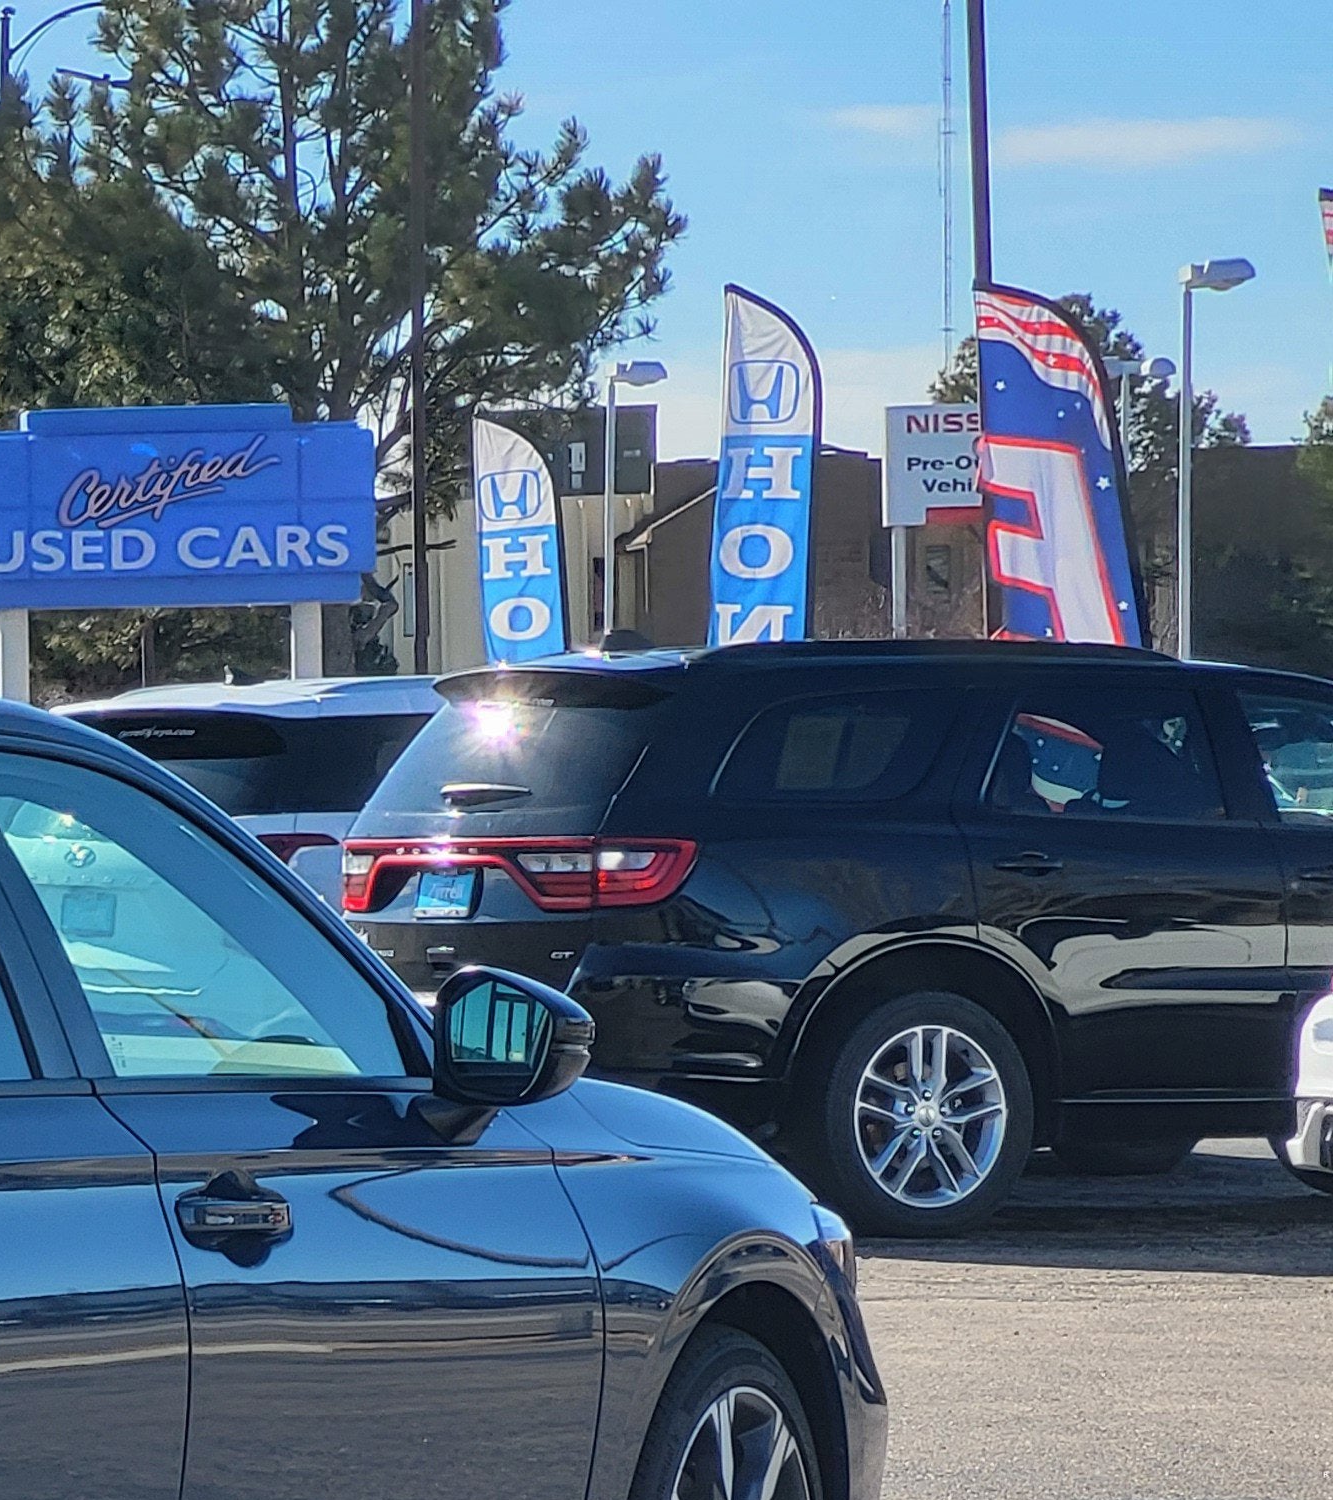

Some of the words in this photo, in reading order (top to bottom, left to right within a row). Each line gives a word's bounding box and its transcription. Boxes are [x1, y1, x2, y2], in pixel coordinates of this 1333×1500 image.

[907, 455, 979, 471] Pre-O
[56, 434, 282, 529] Certified
[922, 477, 972, 492] Vehi
[176, 525, 350, 570] CARS
[550, 951, 575, 959] GT
